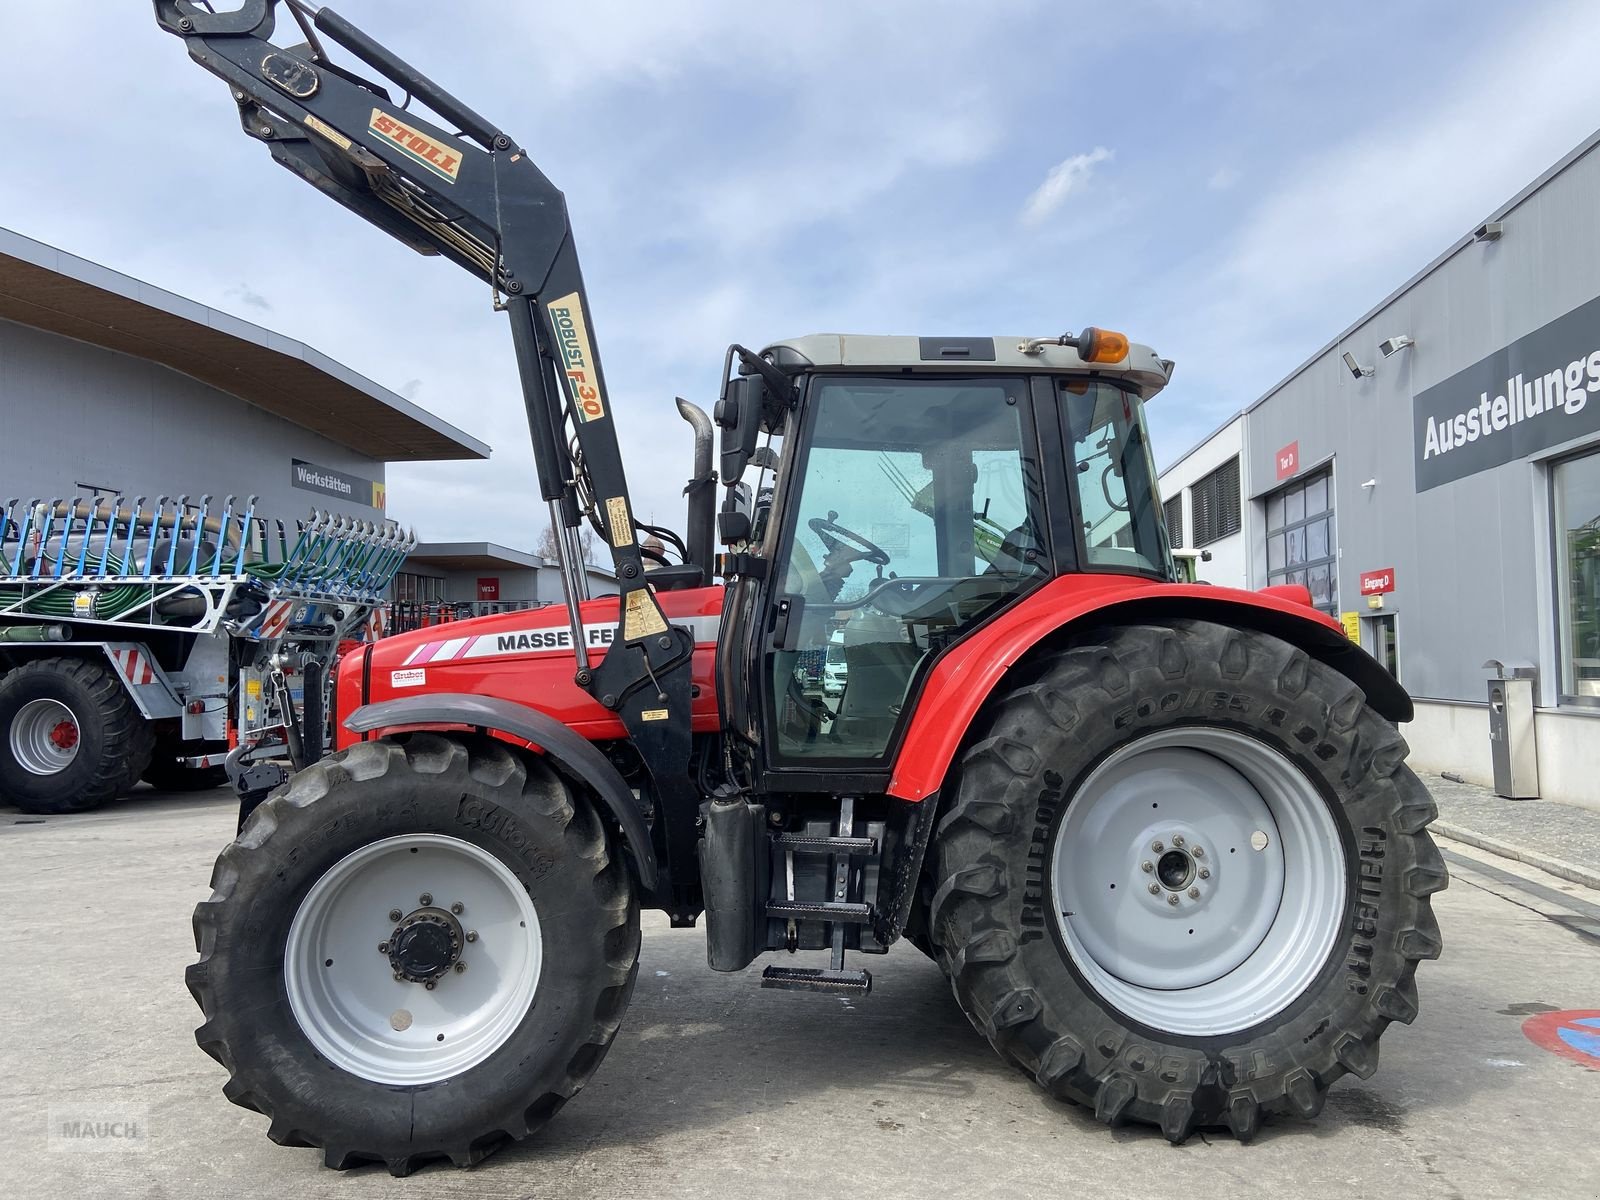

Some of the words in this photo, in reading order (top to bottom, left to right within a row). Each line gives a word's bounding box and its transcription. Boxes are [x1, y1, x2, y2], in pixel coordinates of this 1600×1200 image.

[373, 115, 457, 174] STOLL
[555, 308, 585, 368] ROBUST
[567, 370, 586, 384] F
[579, 386, 601, 415] 30
[1423, 350, 1600, 460] Ausstellungs
[1288, 453, 1294, 467] D
[297, 467, 351, 494] Werkstätten
[1364, 577, 1384, 590] Eingang
[1384, 575, 1389, 586] D
[497, 630, 575, 651] MASSE
